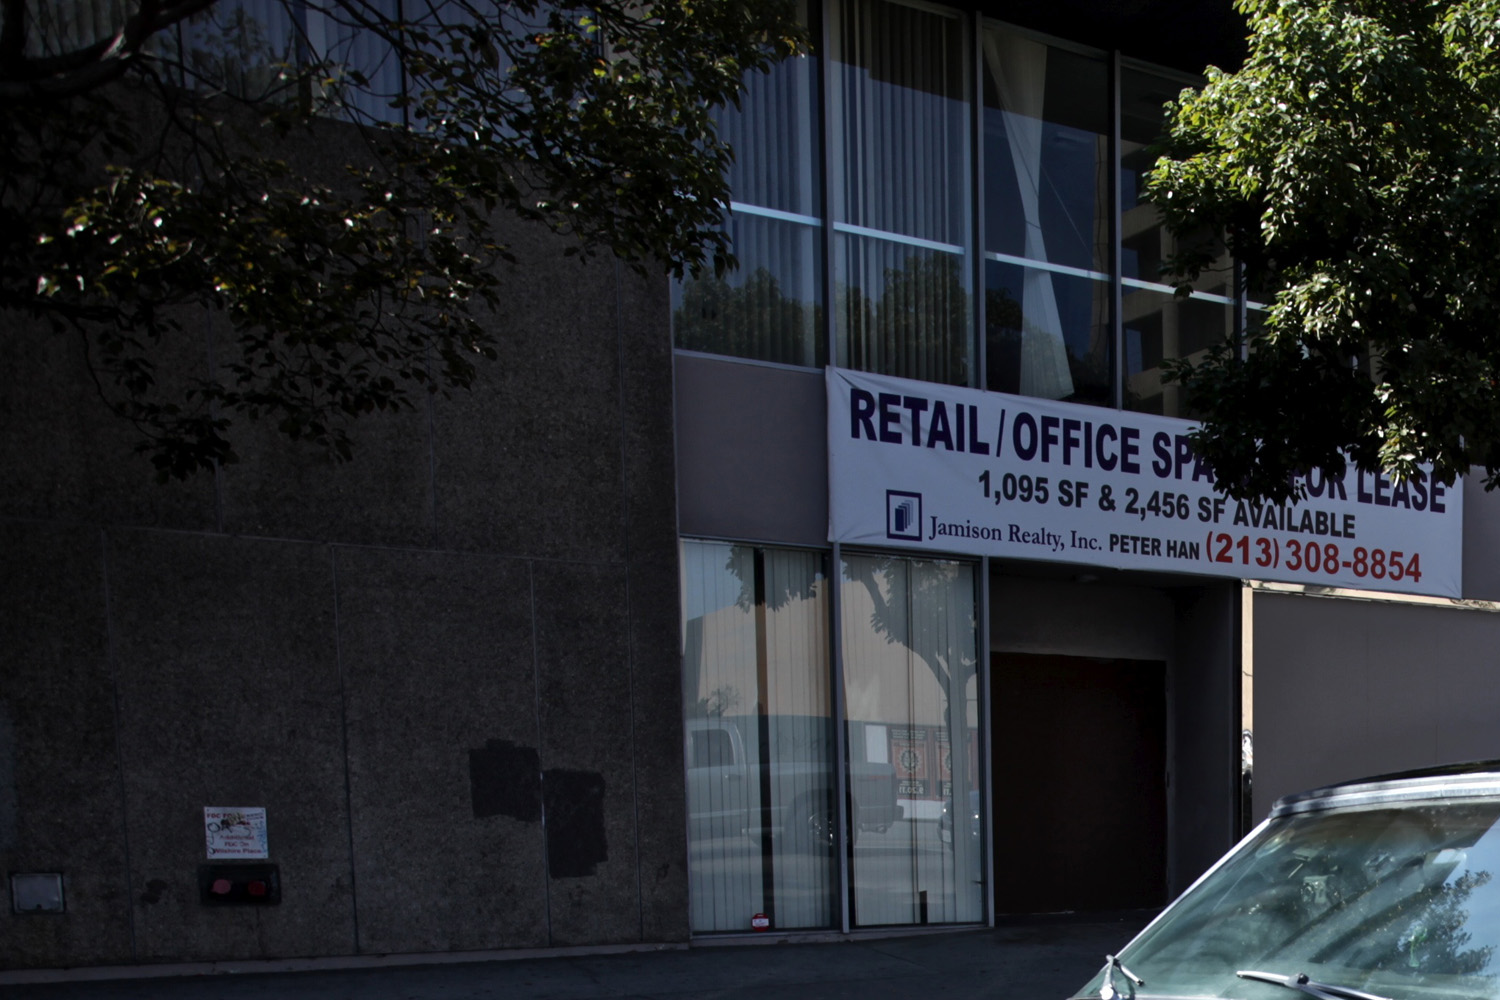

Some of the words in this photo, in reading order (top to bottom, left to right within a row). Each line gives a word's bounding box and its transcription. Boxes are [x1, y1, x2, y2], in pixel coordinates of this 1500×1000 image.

[978, 469, 1050, 505] 1,095
[1058, 479, 1089, 508] SF
[1099, 484, 1116, 512] &
[1125, 487, 1190, 521] 2,456
[1197, 497, 1226, 523] SF
[1233, 501, 1356, 539] AVAILABLE
[1357, 466, 1446, 513] LEASE
[929, 516, 1002, 540] Jamison
[1008, 523, 1065, 552] Realty,
[1071, 530, 1102, 551] Inc.
[1110, 533, 1161, 557] PETER
[1166, 540, 1200, 560] HAN
